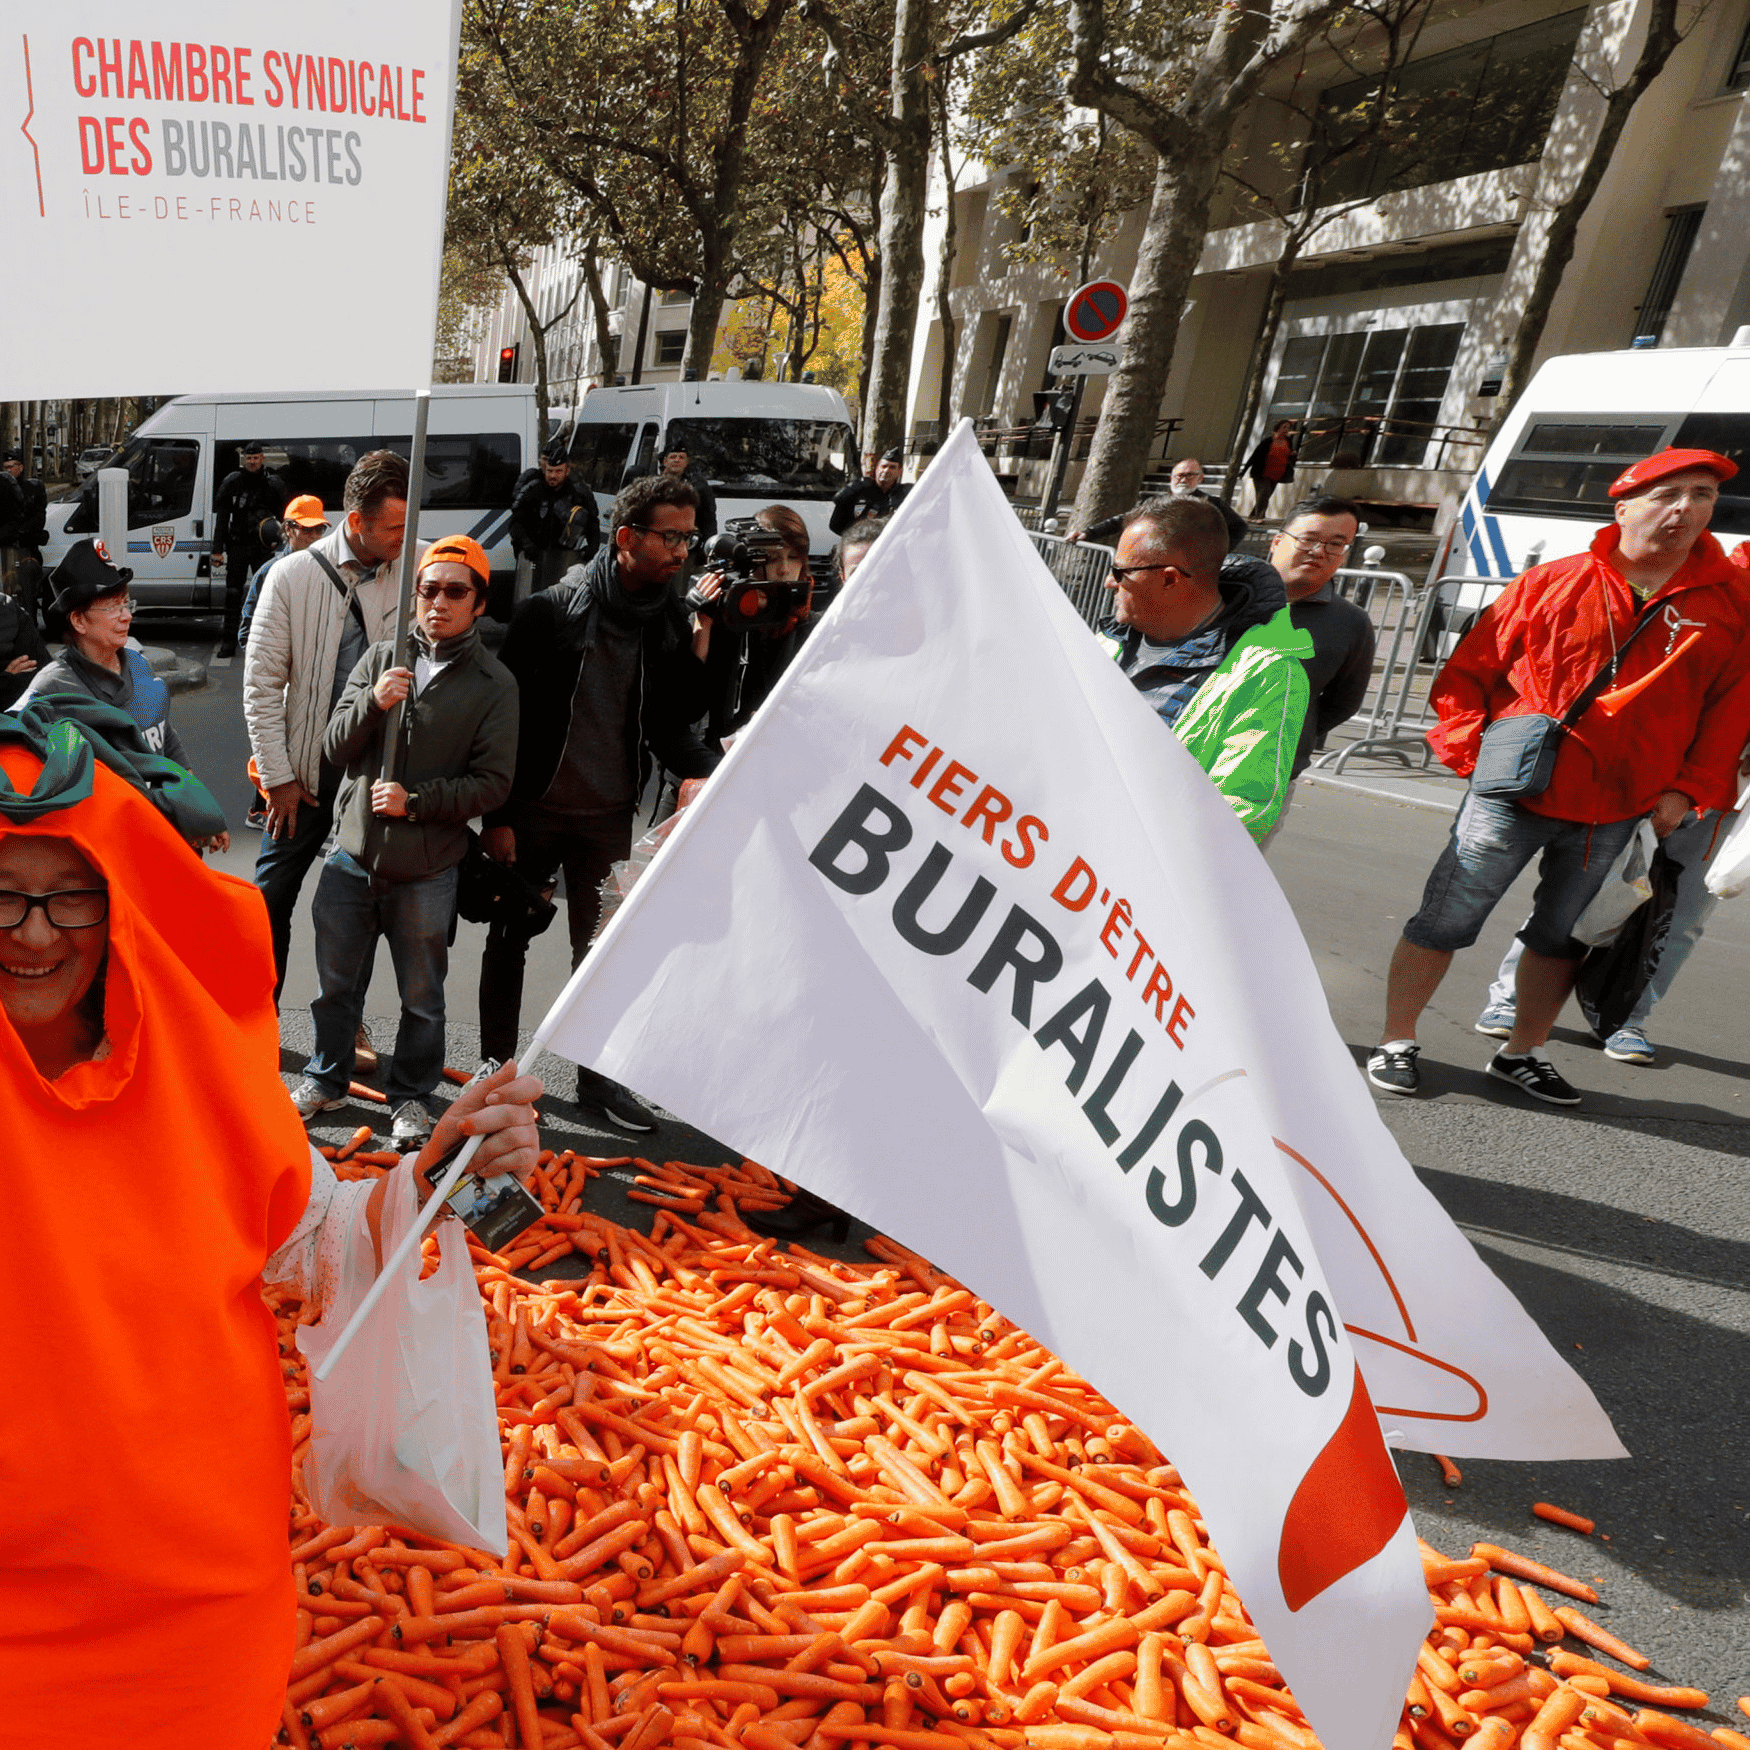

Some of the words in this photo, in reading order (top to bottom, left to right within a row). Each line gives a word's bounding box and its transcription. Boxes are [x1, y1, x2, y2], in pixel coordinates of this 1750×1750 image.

[71, 36, 255, 106] CHAMBRE
[263, 50, 427, 123] SYNDICALE
[78, 116, 153, 176] DES
[162, 119, 363, 186] BURALISTES
[83, 188, 317, 224] ÎLE-DE-FRANCE
[154, 536, 173, 544] CRS
[878, 724, 1049, 870] FIERS
[1050, 855, 1196, 1052] D'ÊTRE
[807, 783, 1338, 1398] BURALISTES
